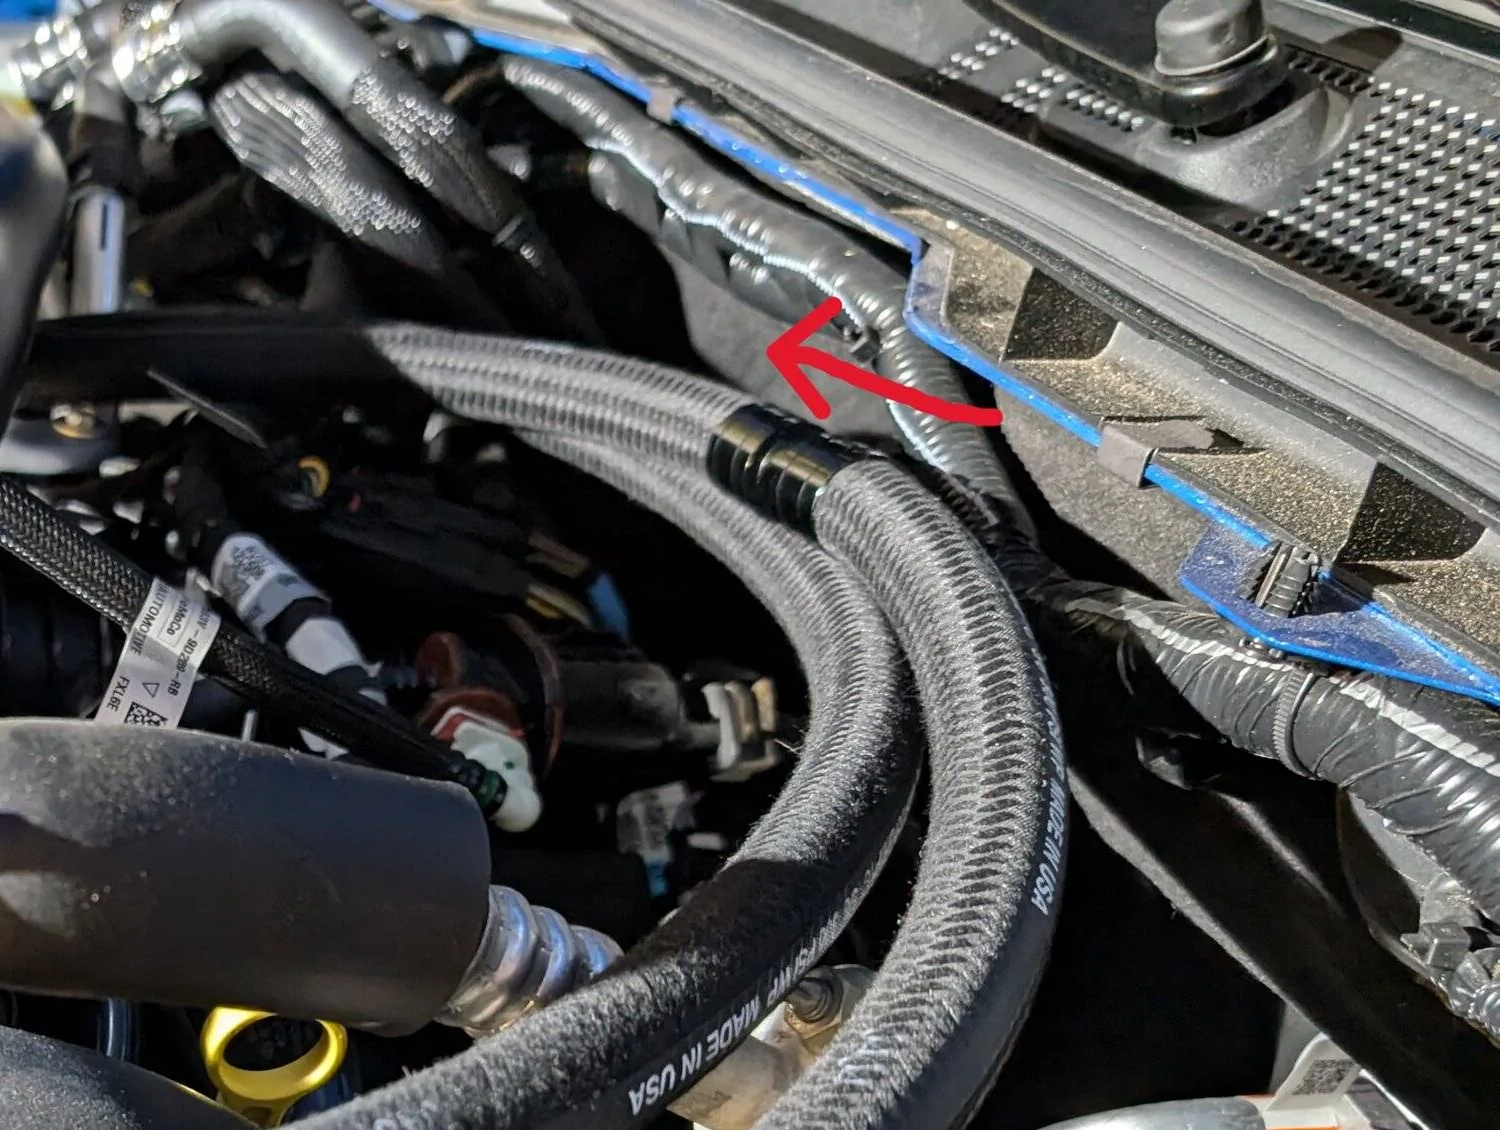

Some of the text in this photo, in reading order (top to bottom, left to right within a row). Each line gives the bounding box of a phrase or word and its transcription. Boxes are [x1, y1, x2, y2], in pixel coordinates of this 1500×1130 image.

[132, 583, 170, 656] AUTOMOTIVE
[1047, 778, 1068, 842] MADE
[1043, 836, 1062, 872] IN
[1030, 863, 1057, 916] USA
[706, 996, 762, 1060] MADE
[681, 1043, 703, 1082] IN
[628, 1065, 676, 1116] USA
